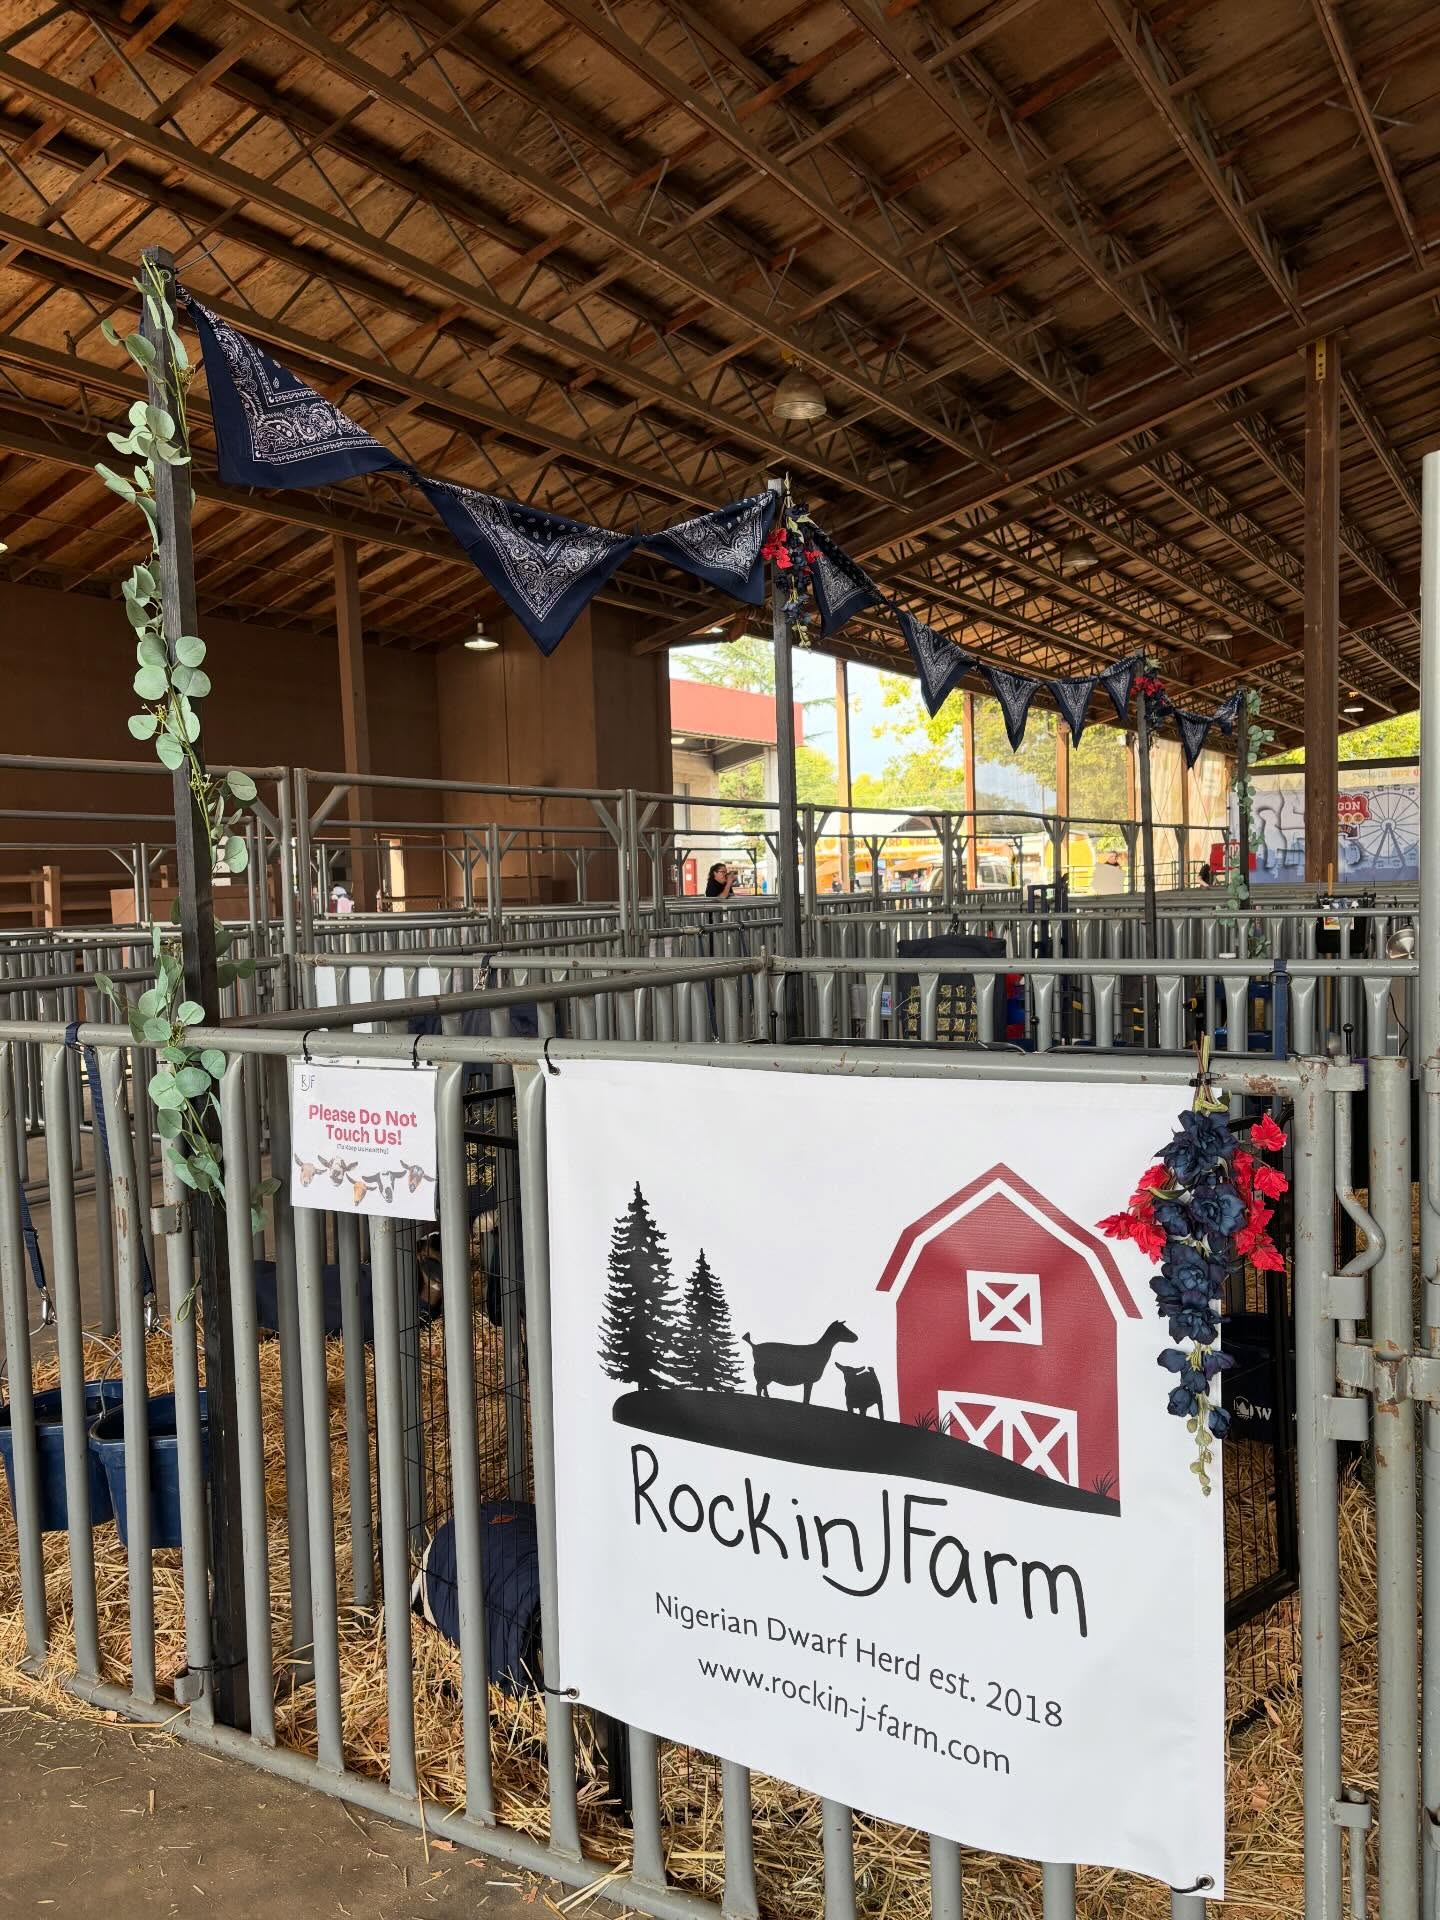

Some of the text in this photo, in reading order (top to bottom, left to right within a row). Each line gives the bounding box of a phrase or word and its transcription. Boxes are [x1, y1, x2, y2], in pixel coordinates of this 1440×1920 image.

[309, 1104, 418, 1128] Please Do Not
[326, 1125, 402, 1146] Touch Us!
[655, 1592, 1064, 1727] Nigerian Dwarf Herd est. 2018
[698, 1657, 1011, 1775] www.rockin-j-farm.com
